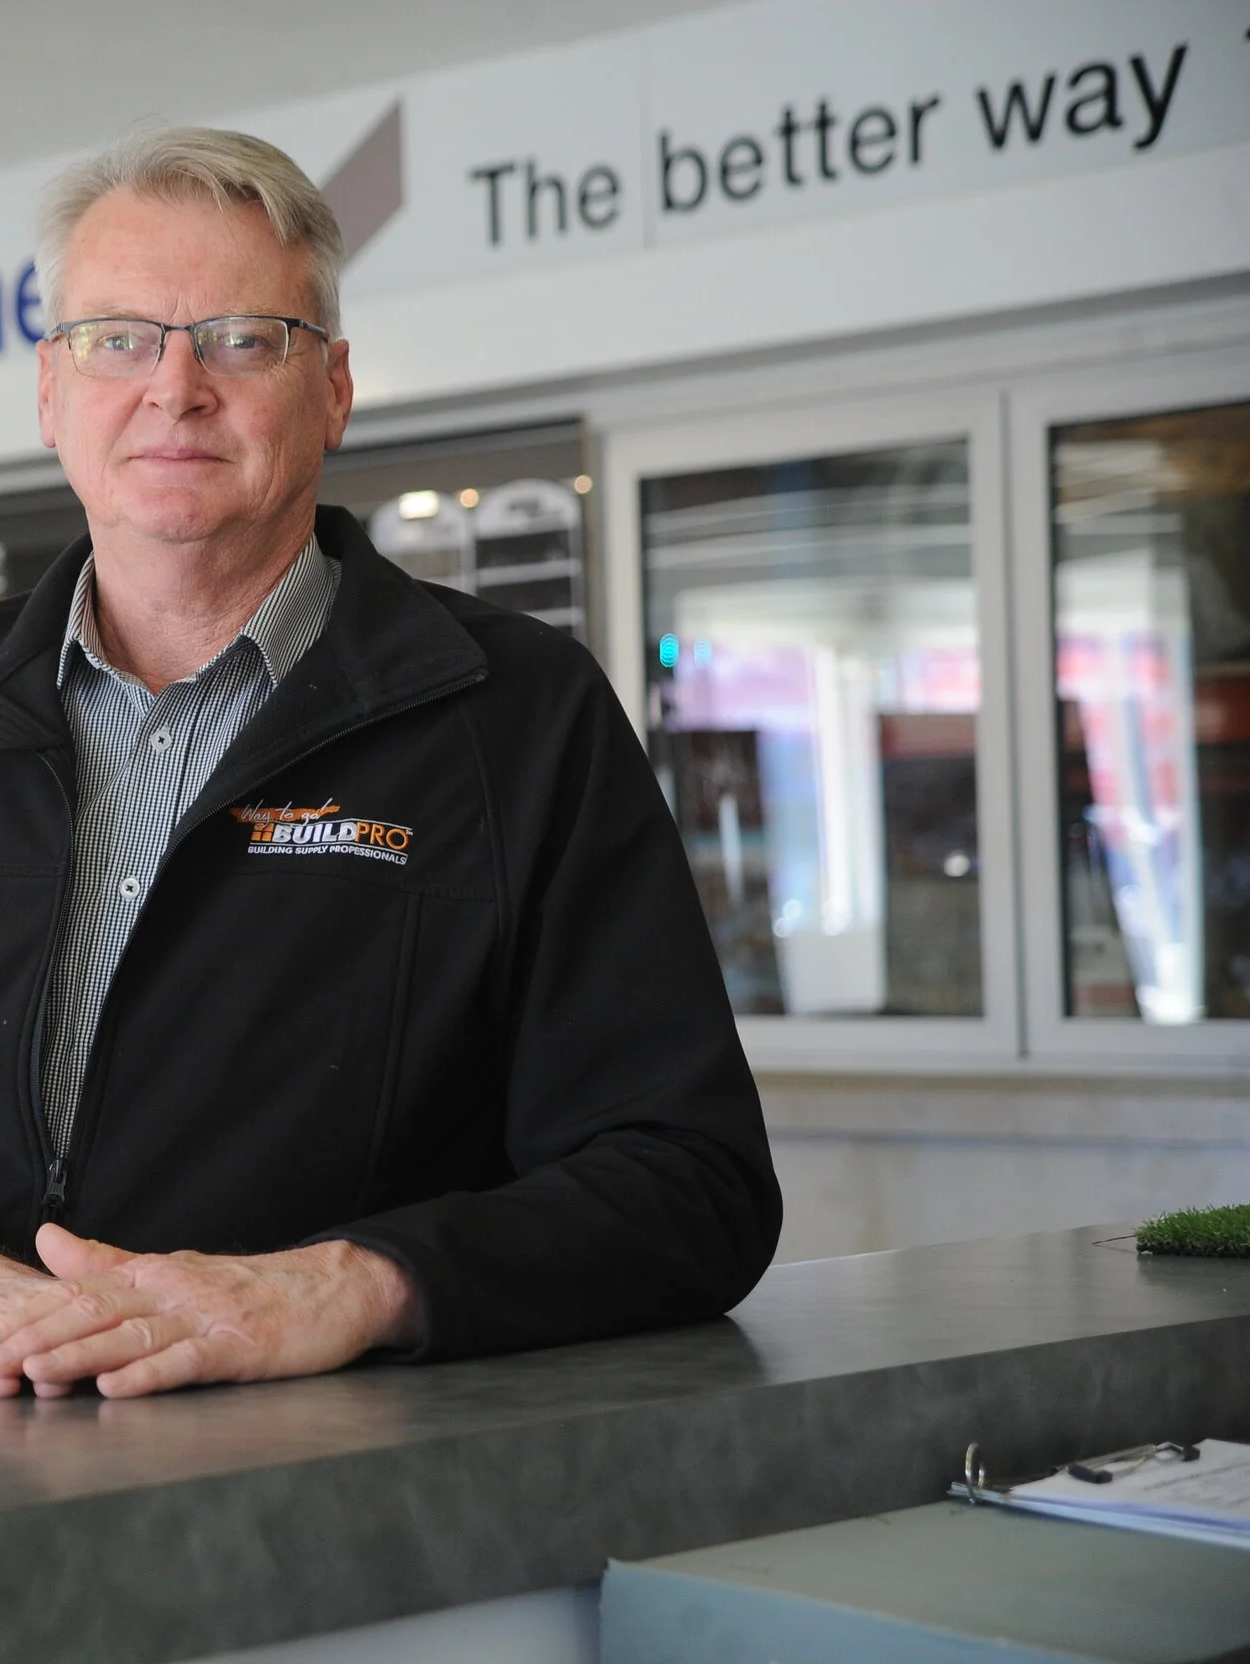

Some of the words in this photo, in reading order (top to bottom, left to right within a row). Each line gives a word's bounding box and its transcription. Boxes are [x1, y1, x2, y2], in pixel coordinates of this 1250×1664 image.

[470, 157, 621, 250] The
[657, 89, 944, 216] better
[976, 42, 1189, 153] way
[275, 800, 294, 821] to
[247, 846, 294, 855] BUILDING
[294, 845, 328, 855] SUPPLY
[329, 845, 408, 866] PROFESSIONALS
